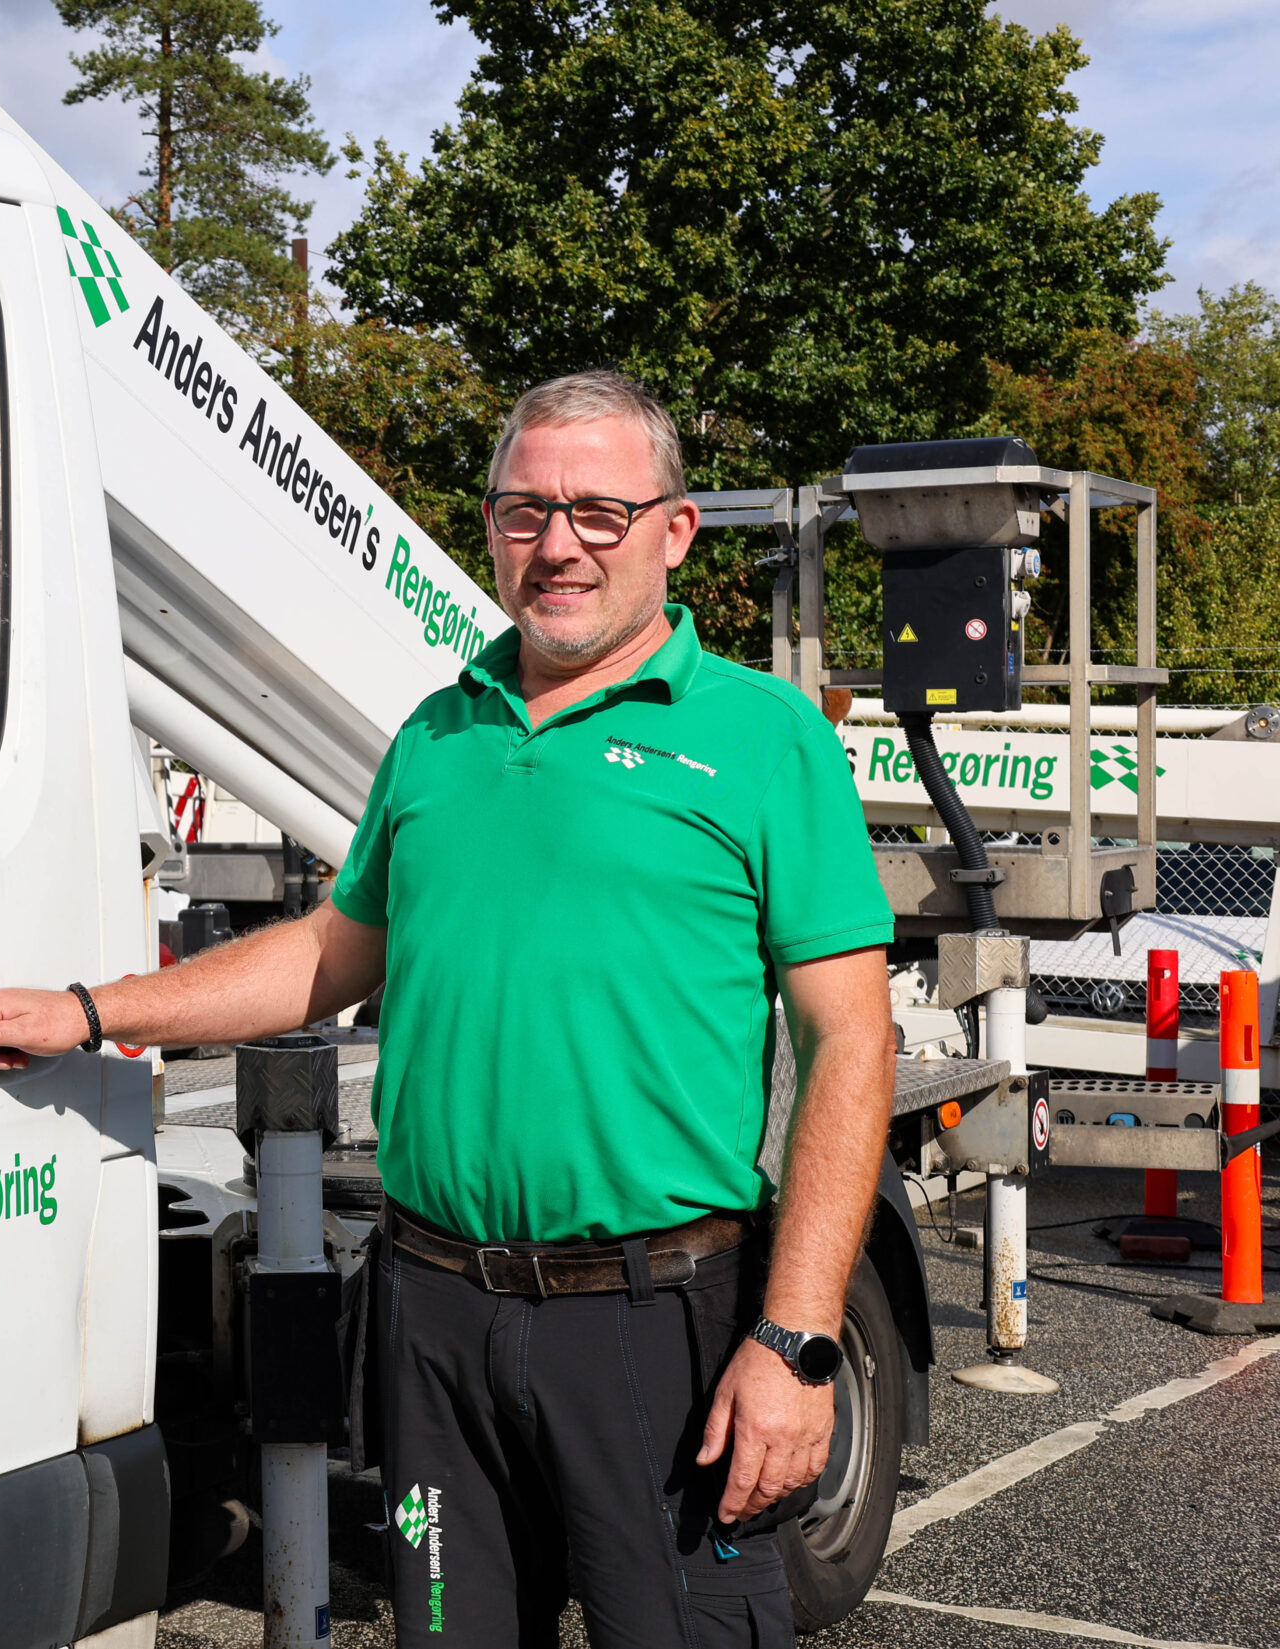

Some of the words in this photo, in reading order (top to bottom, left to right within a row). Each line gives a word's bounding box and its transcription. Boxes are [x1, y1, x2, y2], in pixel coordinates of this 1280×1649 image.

[133, 295, 237, 434] Anders
[239, 397, 381, 571] Andersen's
[385, 534, 493, 664] Rengørin
[606, 736, 632, 748] Anders
[635, 743, 676, 759] Andersen's
[868, 737, 1058, 801] Regøring
[428, 1487, 442, 1524] Anders
[428, 1526, 444, 1580] Andersen's
